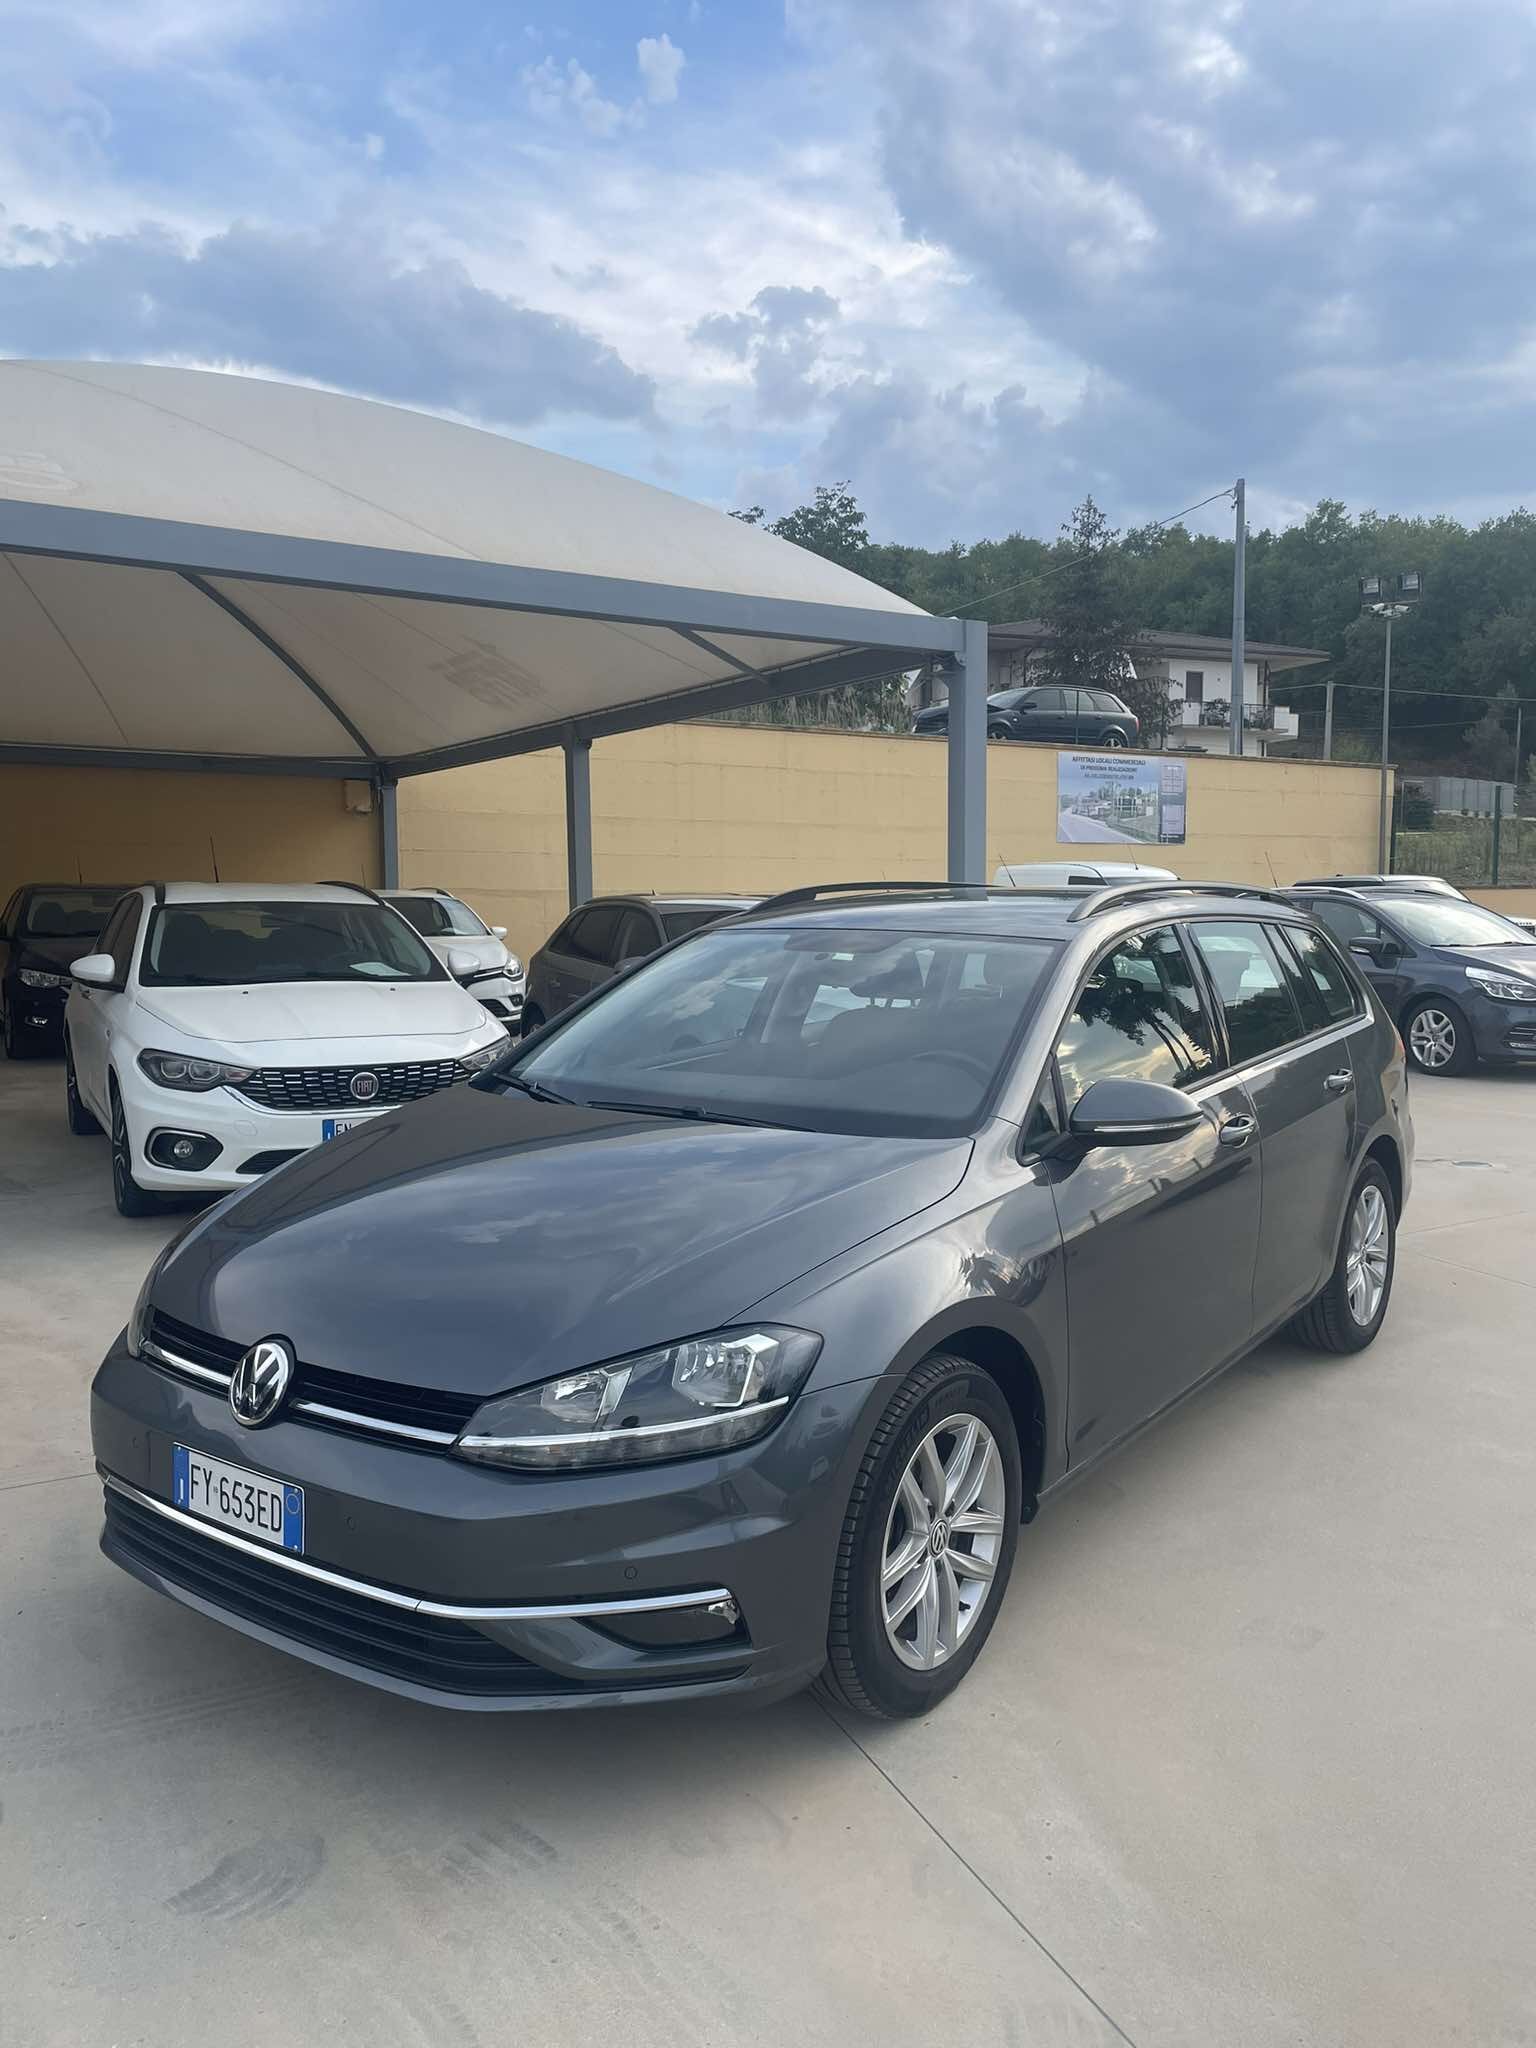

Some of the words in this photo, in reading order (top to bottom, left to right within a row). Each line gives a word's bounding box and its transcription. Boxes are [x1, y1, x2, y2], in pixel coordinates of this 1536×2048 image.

[356, 1080, 373, 1093] FIAT
[191, 1464, 212, 1506] FY
[220, 1476, 281, 1533] 653ED
